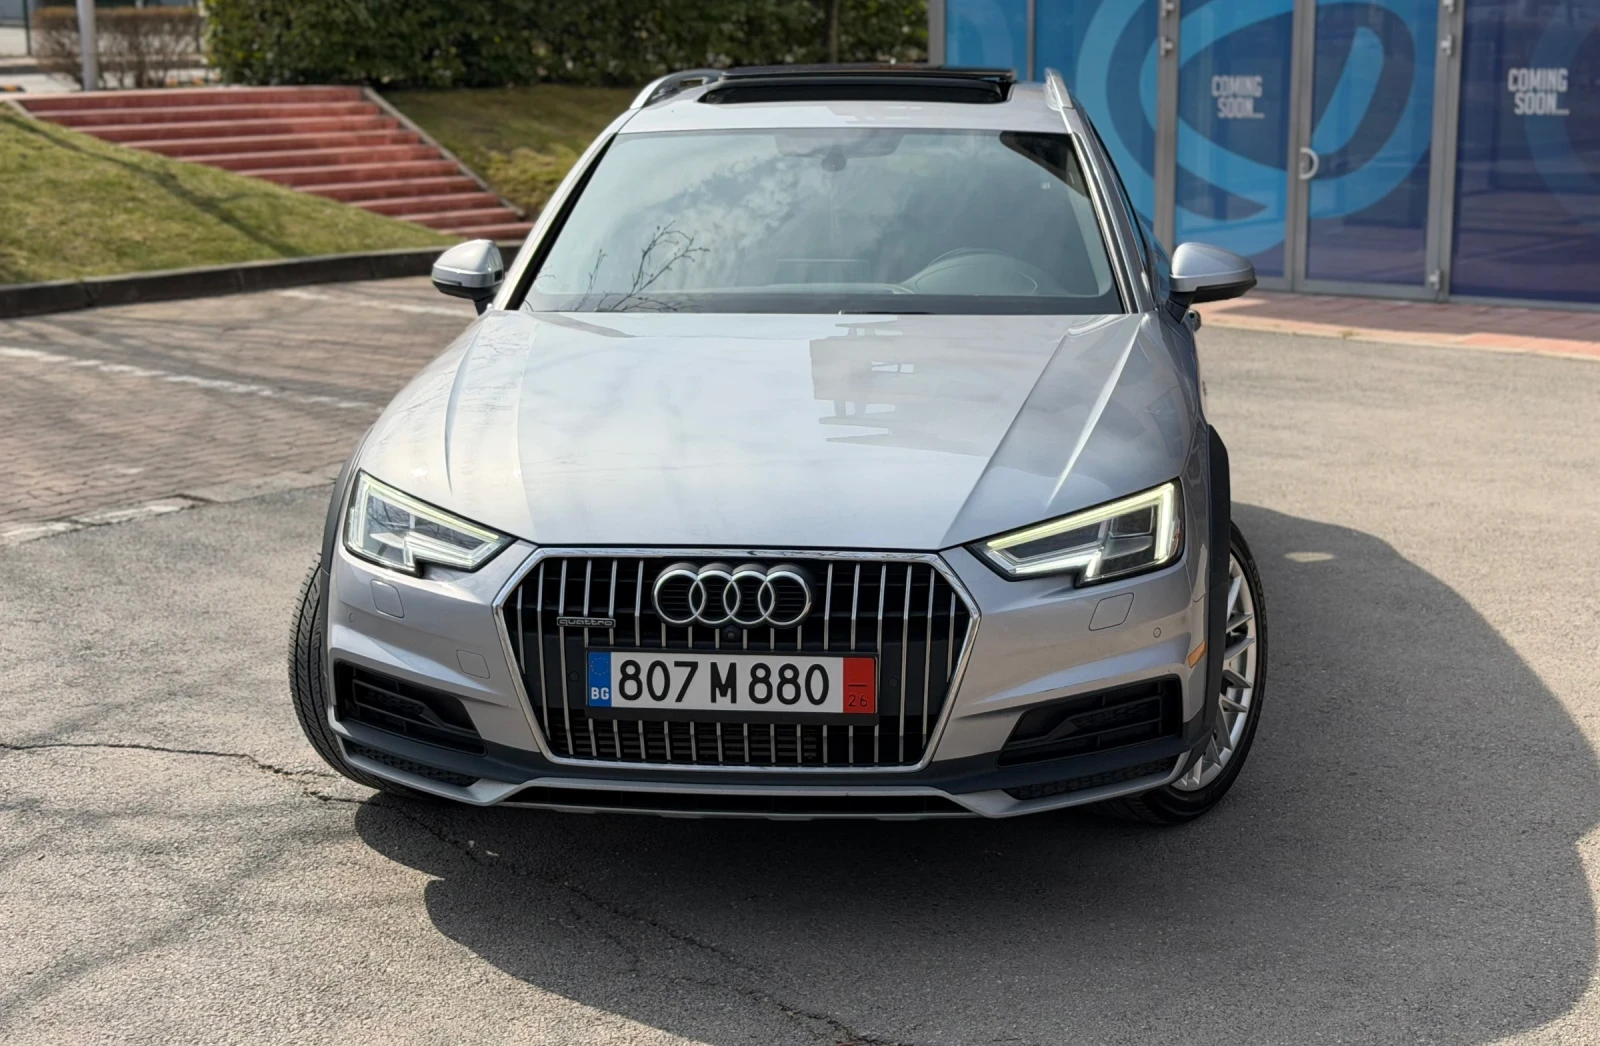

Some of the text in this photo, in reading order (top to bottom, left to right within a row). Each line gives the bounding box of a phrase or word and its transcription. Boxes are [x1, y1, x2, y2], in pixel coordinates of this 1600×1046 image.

[1212, 75, 1263, 97] COMING
[1508, 68, 1569, 92] COMING
[559, 619, 613, 627] quattro
[619, 659, 829, 706] 807 M 880
[591, 687, 610, 700] BG
[848, 693, 868, 708] 26
